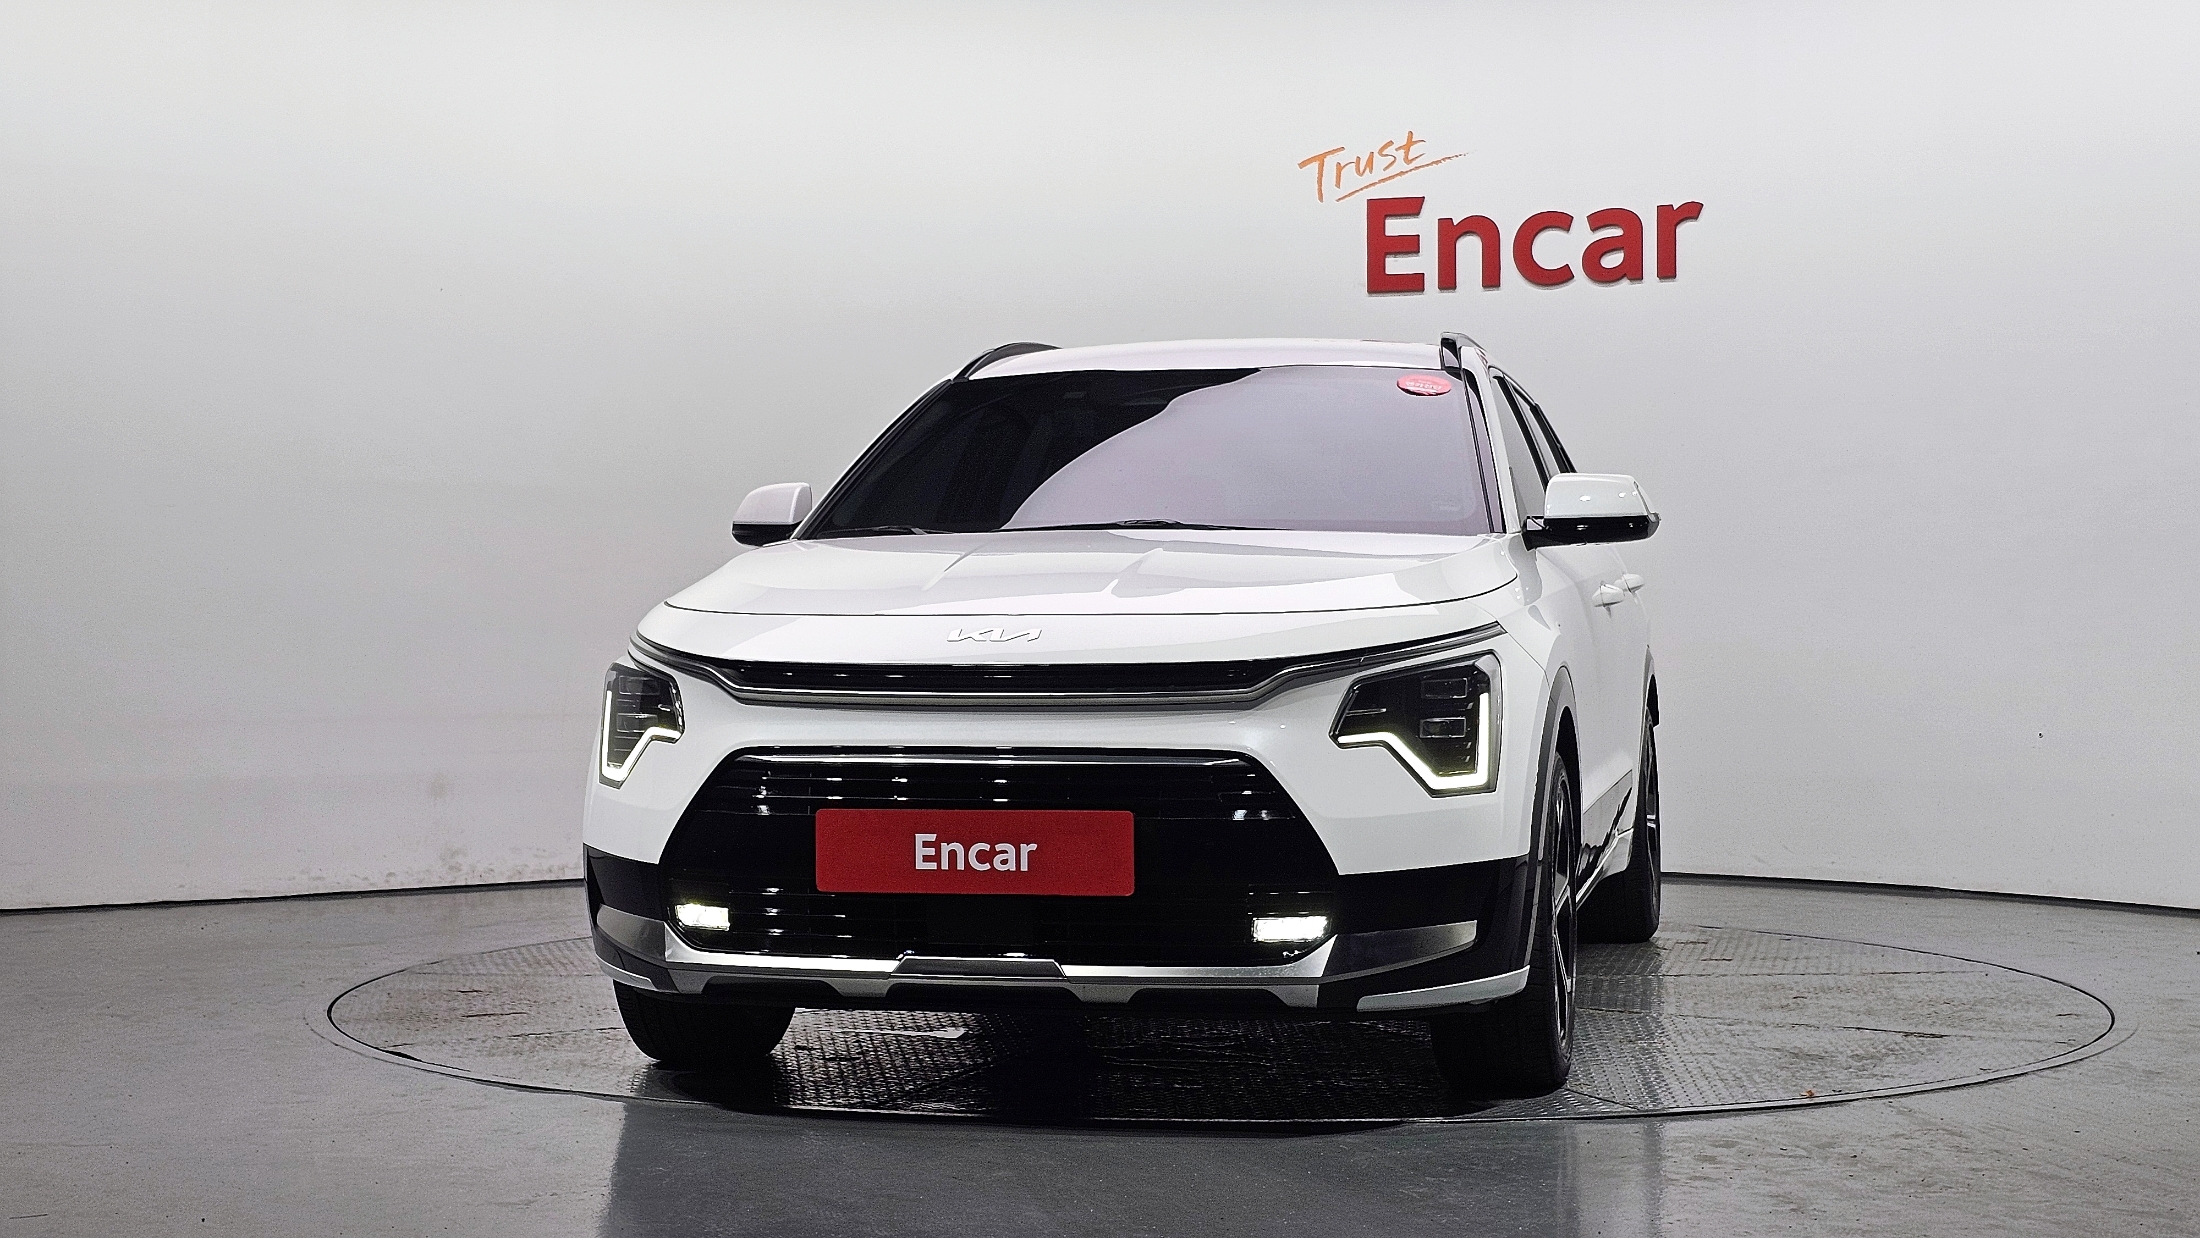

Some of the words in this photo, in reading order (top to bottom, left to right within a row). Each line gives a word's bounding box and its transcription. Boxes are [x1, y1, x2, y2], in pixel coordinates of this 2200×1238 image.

[1298, 131, 1426, 202] Trust
[1366, 196, 1704, 294] Encar
[914, 833, 1037, 872] Encar
